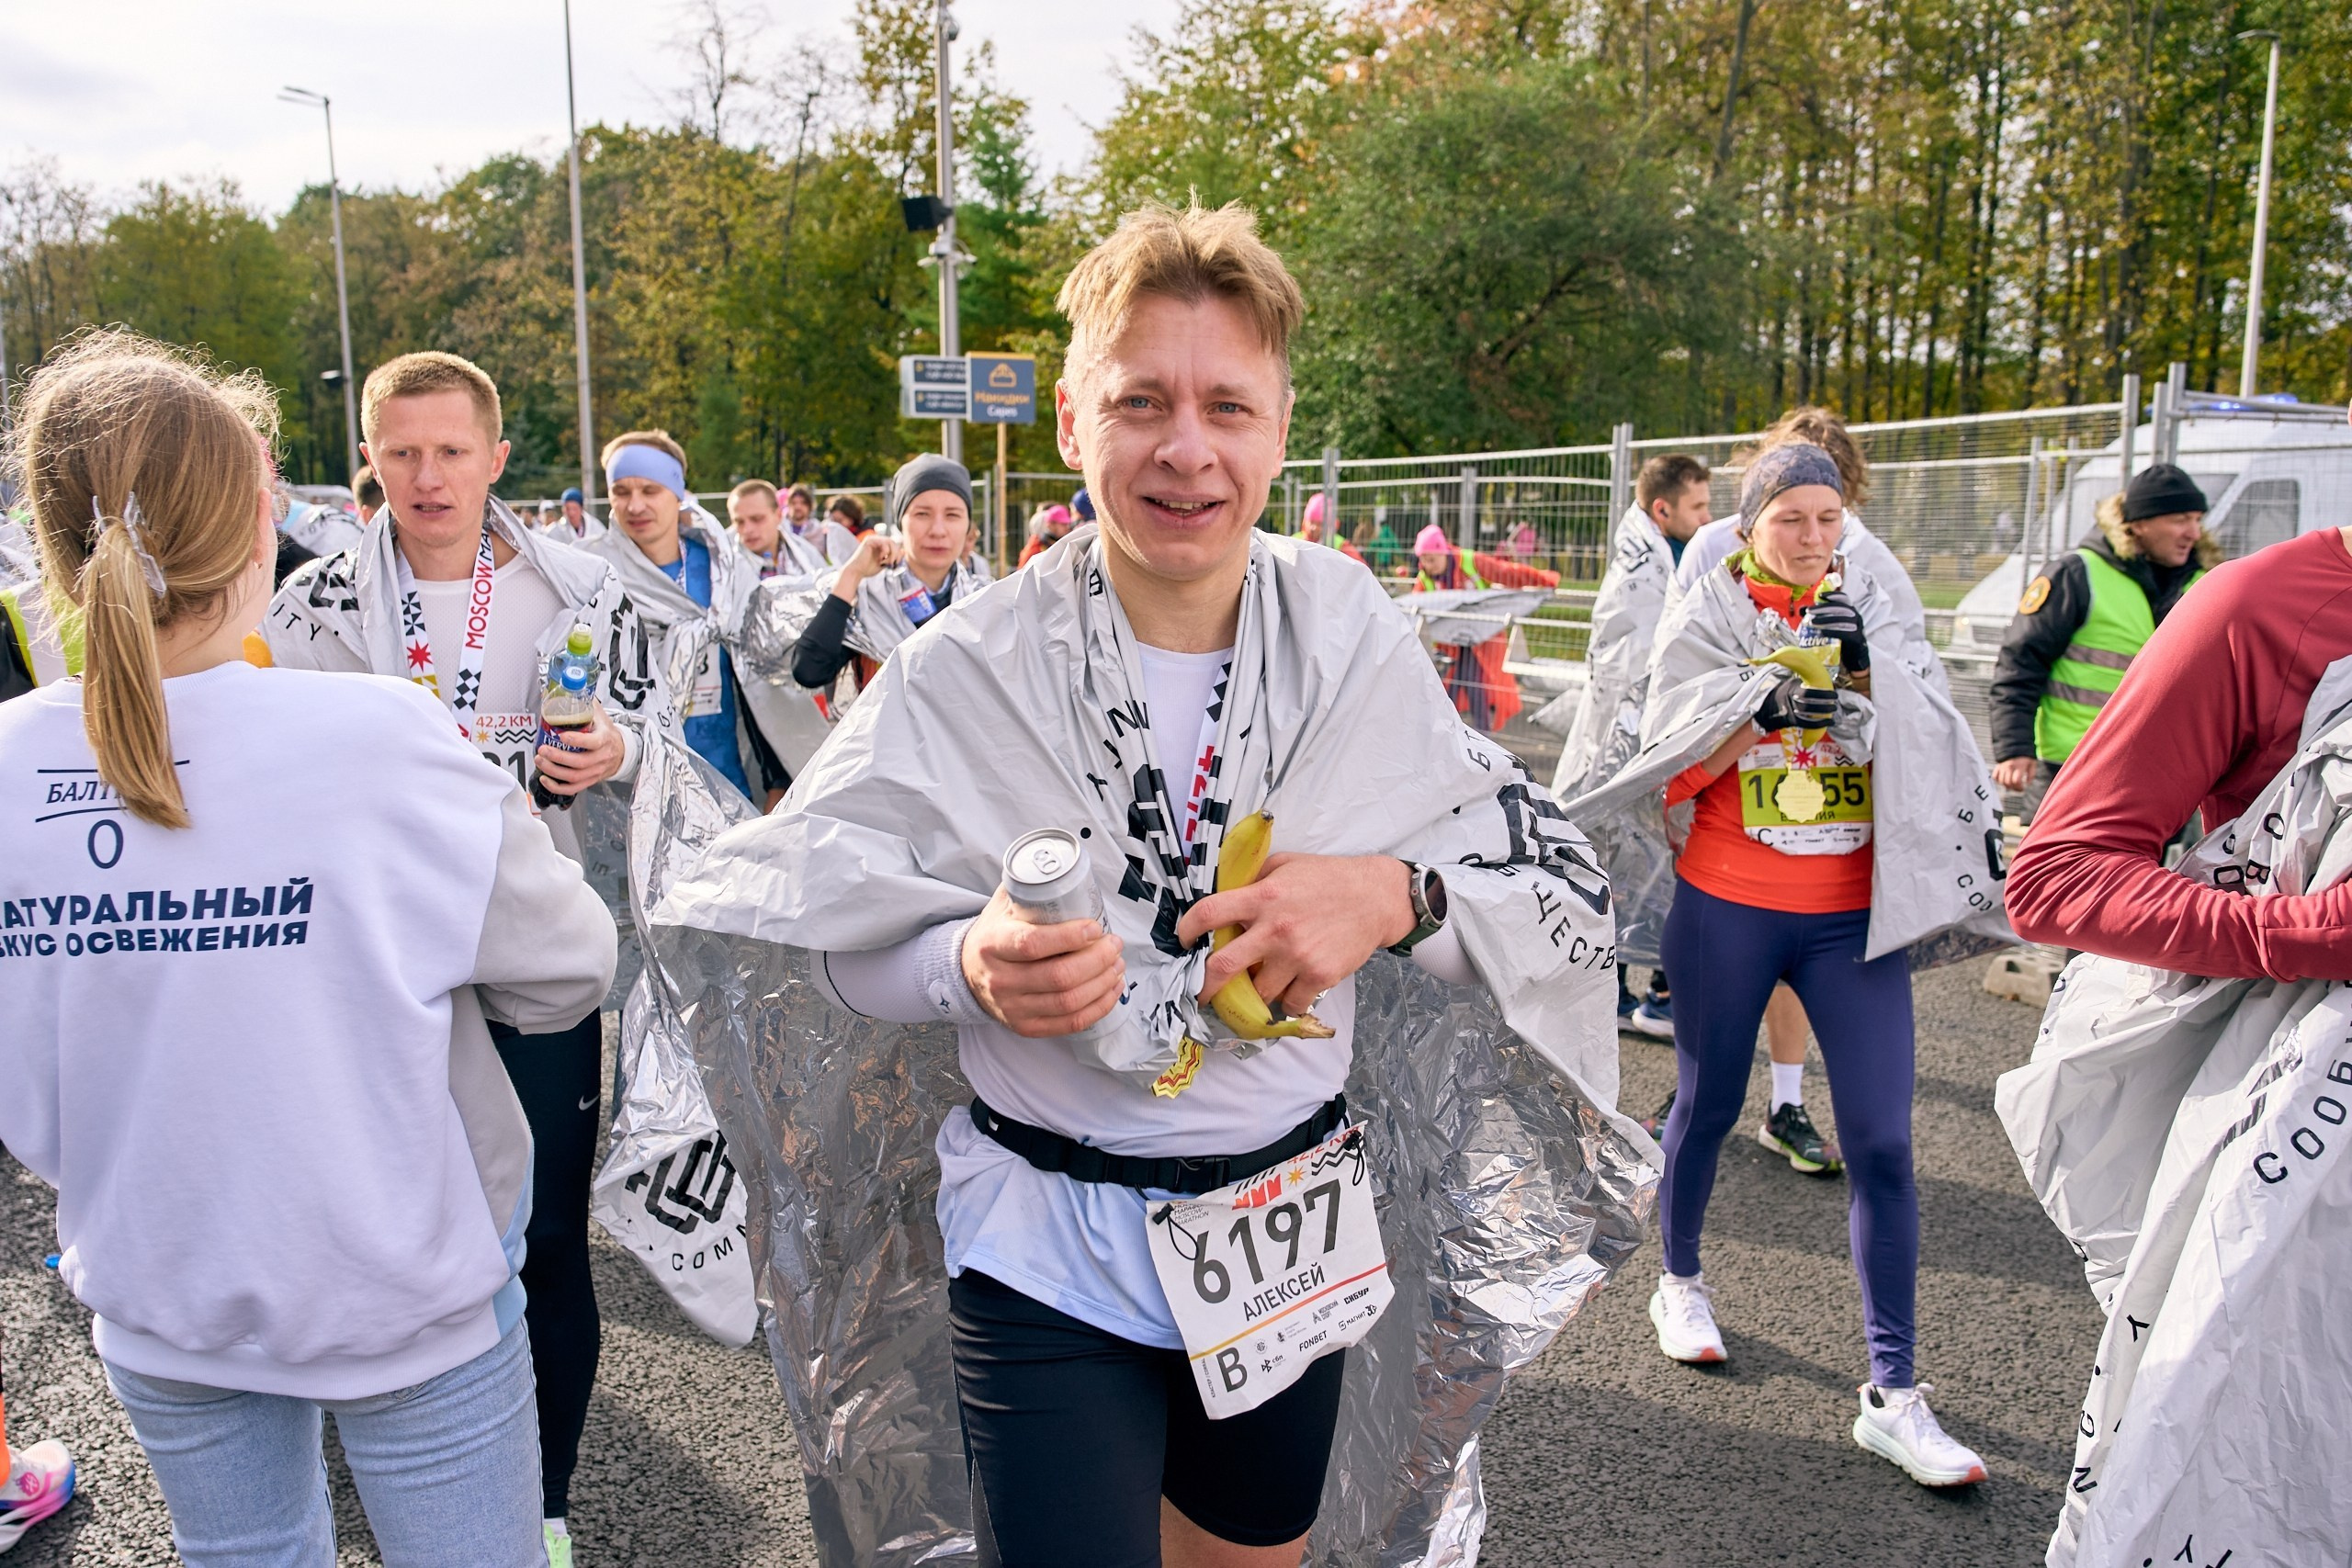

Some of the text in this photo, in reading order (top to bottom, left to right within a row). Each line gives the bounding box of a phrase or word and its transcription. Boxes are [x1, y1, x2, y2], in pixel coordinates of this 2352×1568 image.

[466, 560, 492, 649] MOSCOW
[476, 716, 506, 728] 42,2
[65, 920, 309, 957] ОСВЕЖЕНИЯ
[1193, 1178, 1341, 1304] 6197
[1242, 1261, 1326, 1322] АЛЕКСЕЙ
[1343, 1287, 1370, 1305] СИБУР
[1346, 1311, 1367, 1325] МАГНИТ
[1298, 1330, 1328, 1352] FONBET
